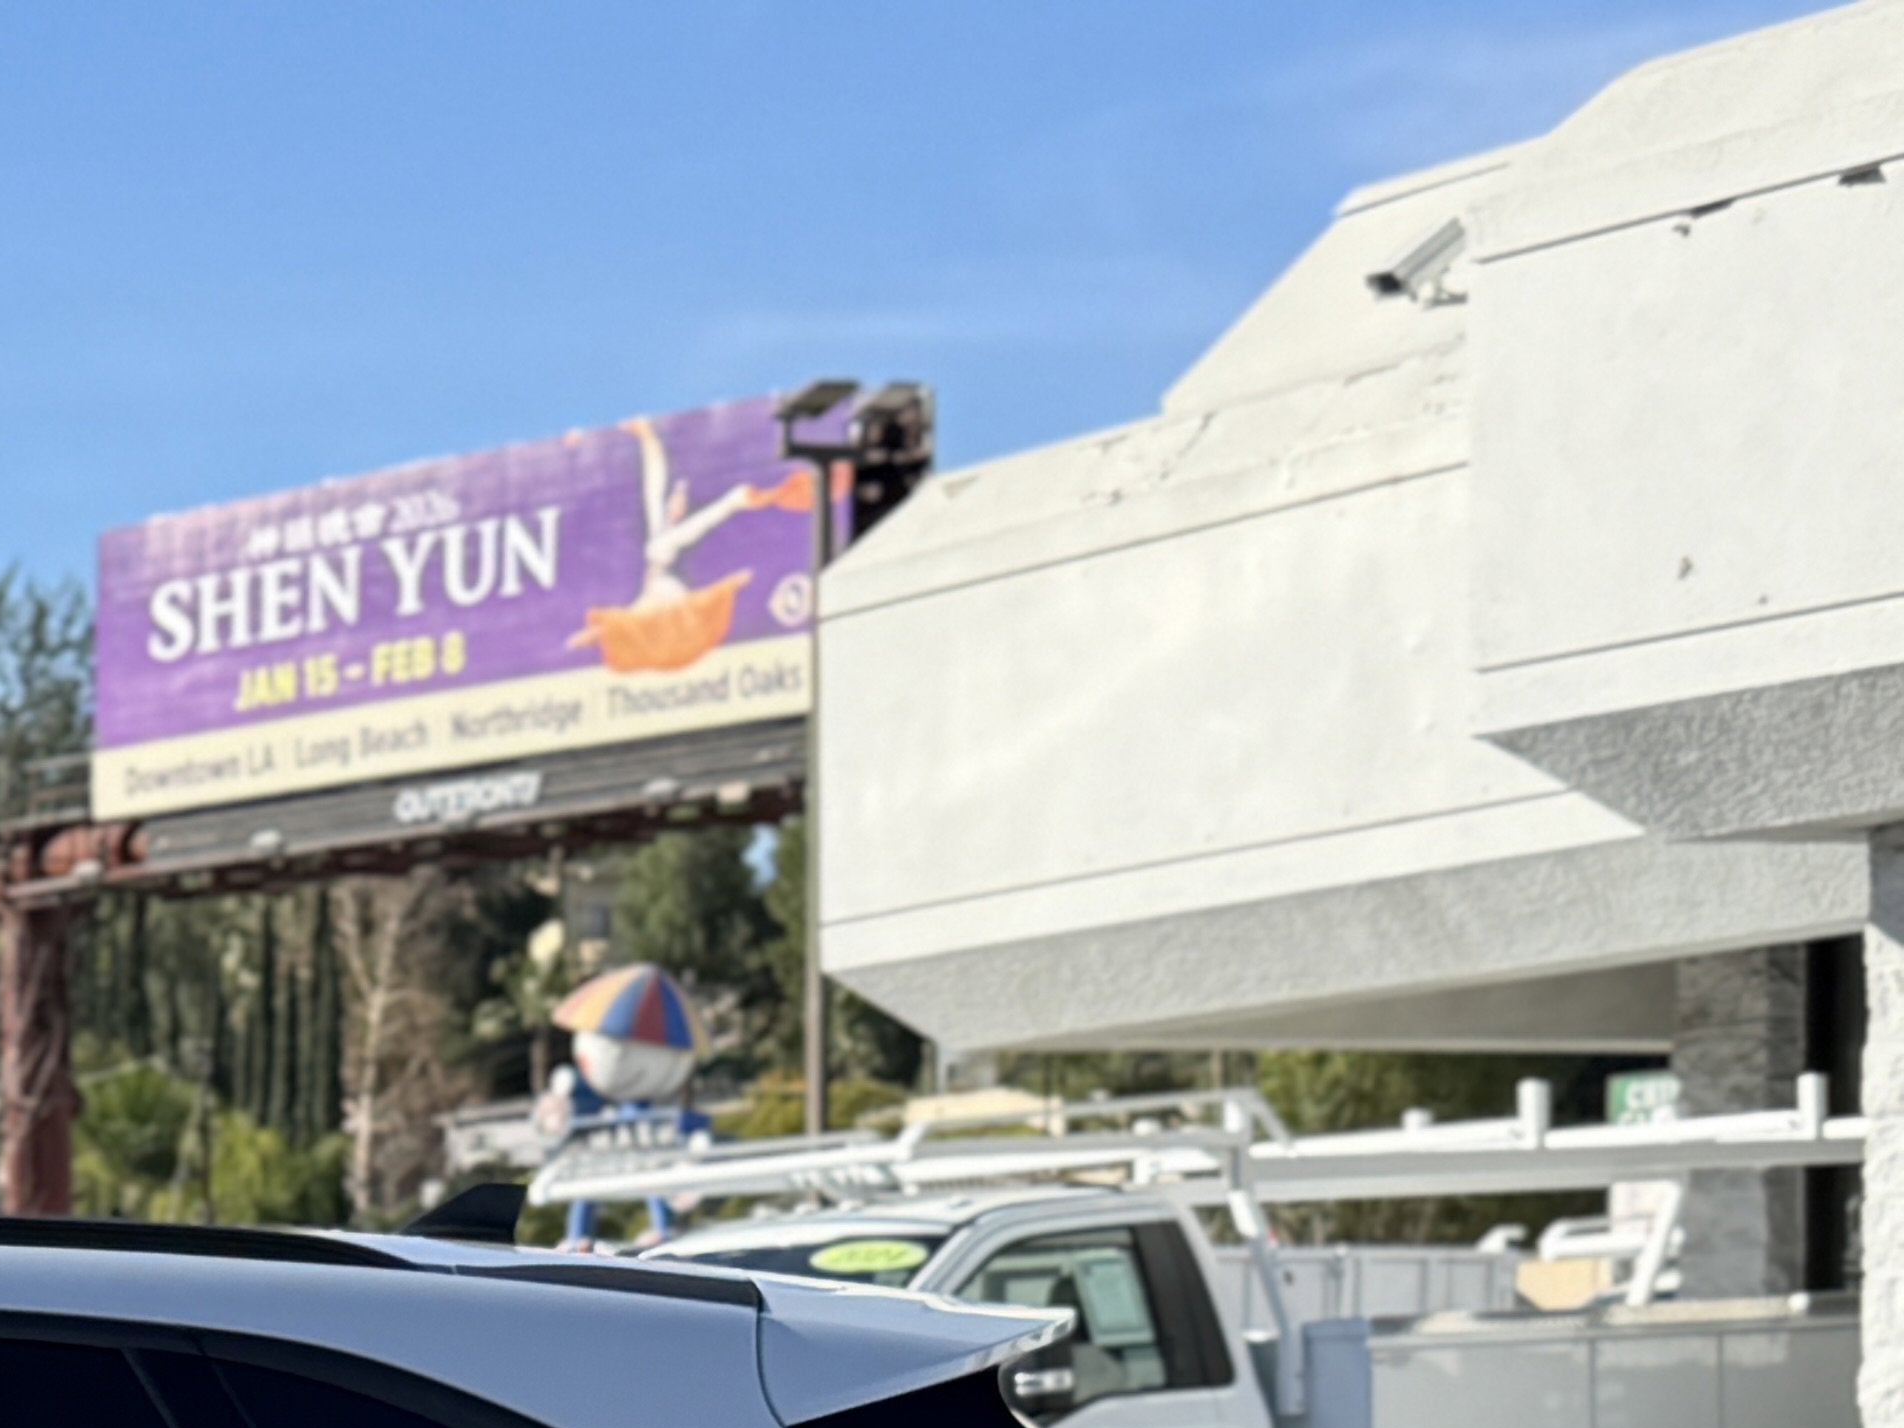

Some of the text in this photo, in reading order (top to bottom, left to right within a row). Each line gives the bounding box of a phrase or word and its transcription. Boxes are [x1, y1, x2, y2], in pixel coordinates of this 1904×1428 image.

[147, 543, 362, 662] SHEN
[380, 505, 561, 617] YUN
[234, 660, 296, 711] JAN
[303, 652, 340, 698] 15
[371, 635, 436, 687] FEB
[606, 662, 802, 718] Thousand Oaks
[294, 720, 428, 769] Long Beach
[451, 697, 583, 738] Northridge
[124, 742, 275, 797] Downtown LA
